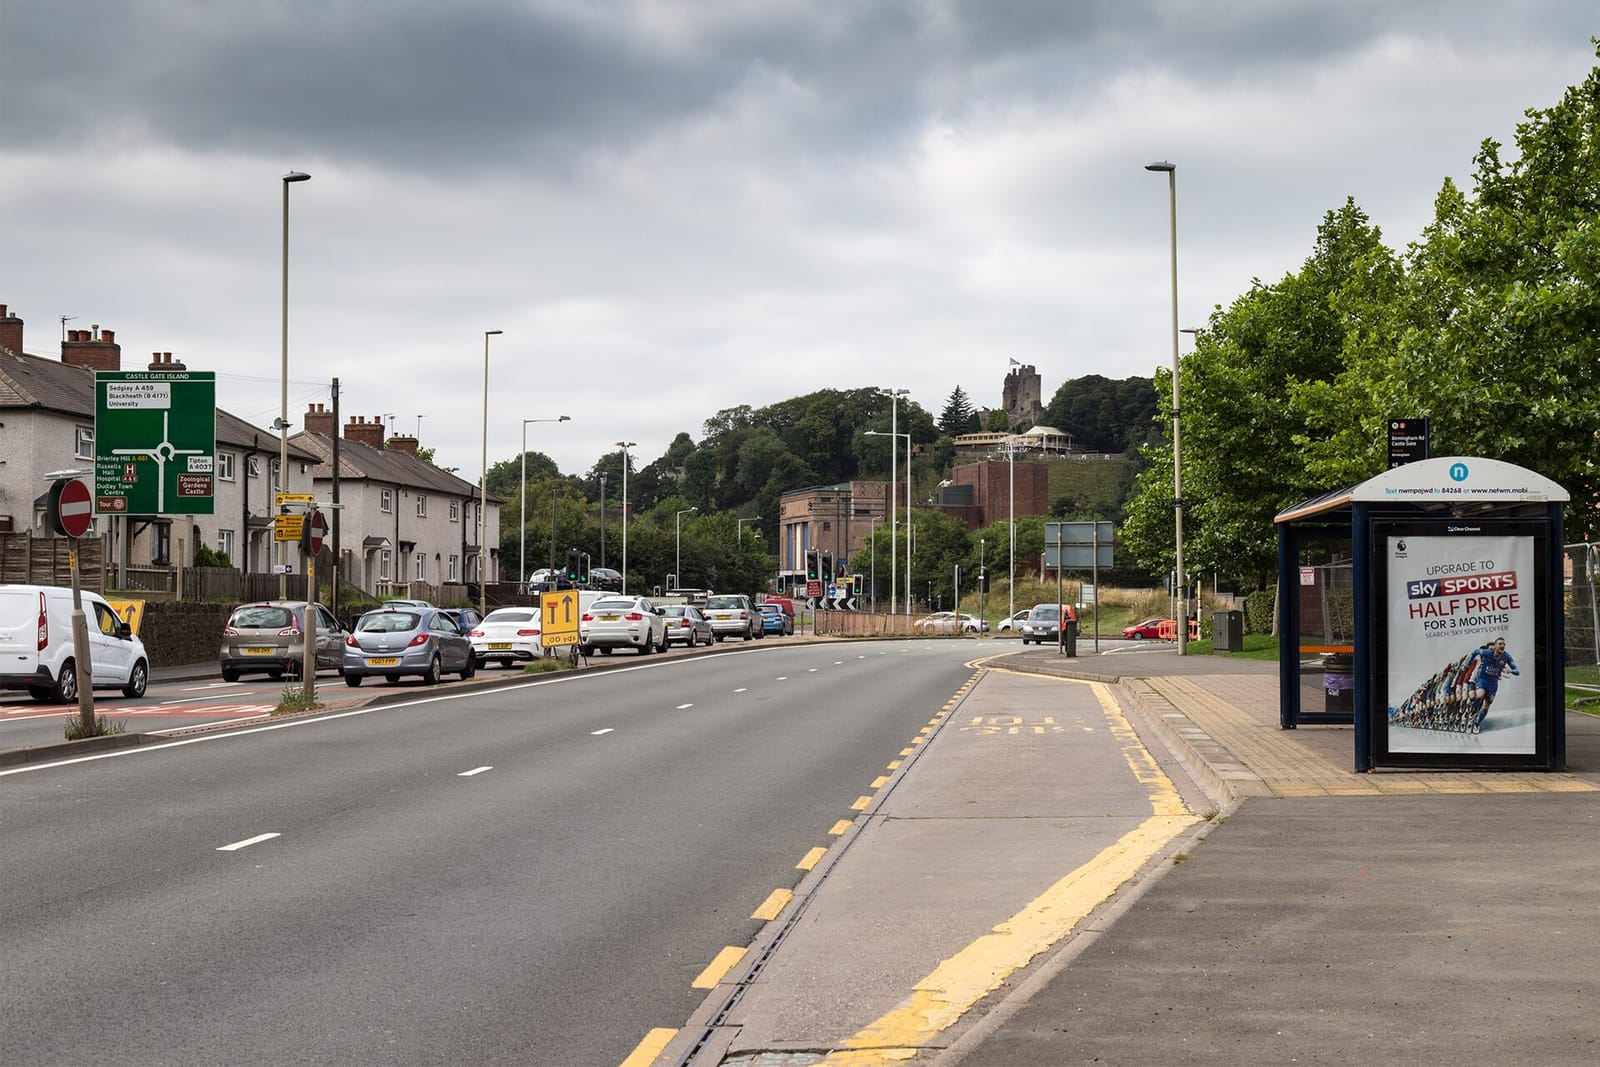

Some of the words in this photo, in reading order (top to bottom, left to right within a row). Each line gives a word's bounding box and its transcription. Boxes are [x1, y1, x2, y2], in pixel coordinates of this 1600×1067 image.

[126, 465, 134, 473] H
[1426, 562, 1476, 576] UPGRADE
[1480, 560, 1494, 570] TO
[1411, 582, 1437, 596] sky
[1444, 574, 1513, 593] SPORTS
[1409, 599, 1460, 619] HALF
[1466, 593, 1520, 614] PRICE
[1424, 620, 1446, 631] FOR
[1450, 619, 1456, 628] 3
[1460, 613, 1509, 626] MONTHS
[1425, 631, 1449, 639] SEARCH
[1464, 627, 1488, 635] SPORTS
